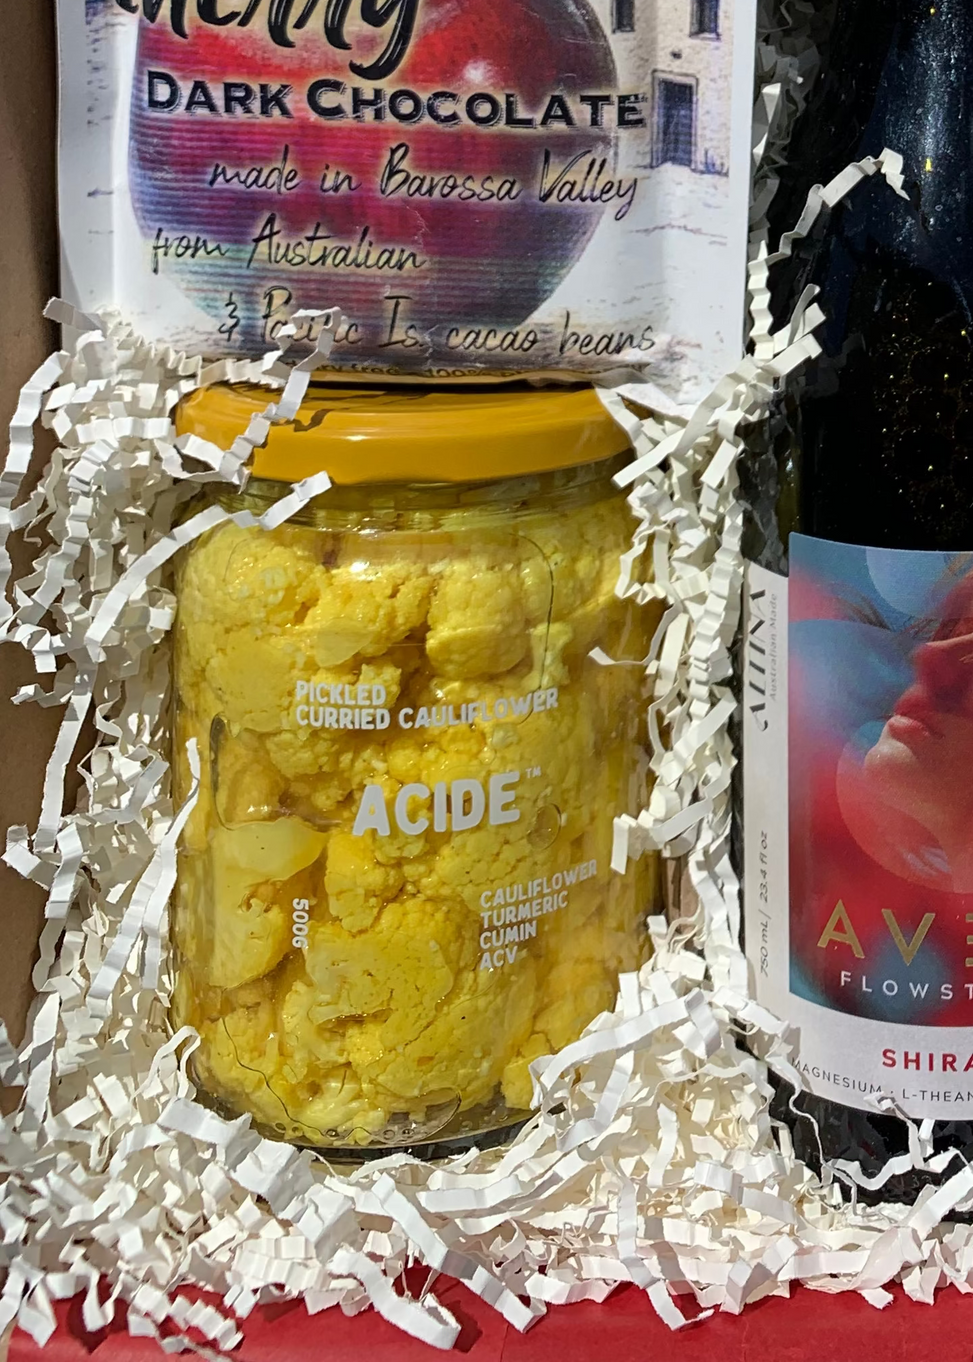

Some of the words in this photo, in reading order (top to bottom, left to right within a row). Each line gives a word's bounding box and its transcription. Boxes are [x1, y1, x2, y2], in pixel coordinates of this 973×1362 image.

[146, 69, 294, 117] DARK
[306, 79, 648, 129] CHOCOLATE
[209, 144, 300, 196] made
[320, 162, 362, 194] in
[379, 143, 522, 202] Barossa
[538, 148, 639, 221] Valley
[151, 227, 229, 273] from
[246, 212, 428, 271] Australian
[446, 326, 538, 353] cacao
[560, 311, 656, 356] beans
[296, 681, 386, 705] PICKLED
[296, 704, 391, 730] CURRIED
[398, 687, 559, 729] CAULIFLOWER
[480, 859, 598, 907] CAULIFLOWER
[291, 897, 309, 949] 500G
[480, 890, 568, 929] TURMERIC
[480, 921, 537, 951] CUMIN
[480, 944, 519, 971] ACV
